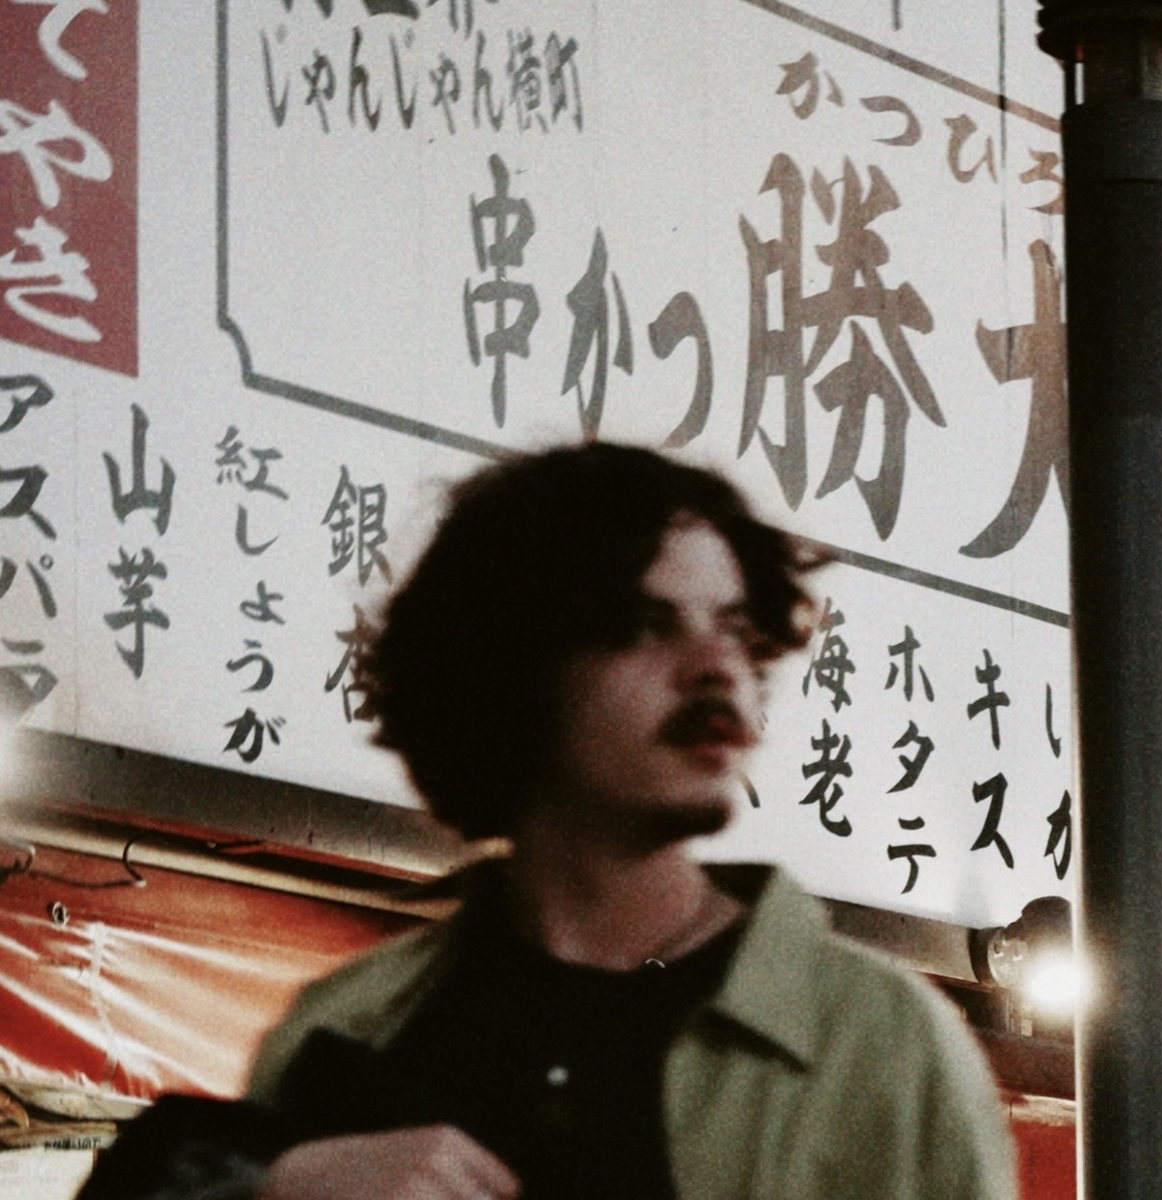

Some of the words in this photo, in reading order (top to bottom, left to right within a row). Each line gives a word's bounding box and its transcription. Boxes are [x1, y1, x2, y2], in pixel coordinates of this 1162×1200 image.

[101, 402, 177, 680] 山芋
[215, 426, 289, 763] 紅しょうが
[799, 597, 856, 837] 海老
[885, 625, 937, 894] ホタテ
[967, 648, 1014, 869] キス
